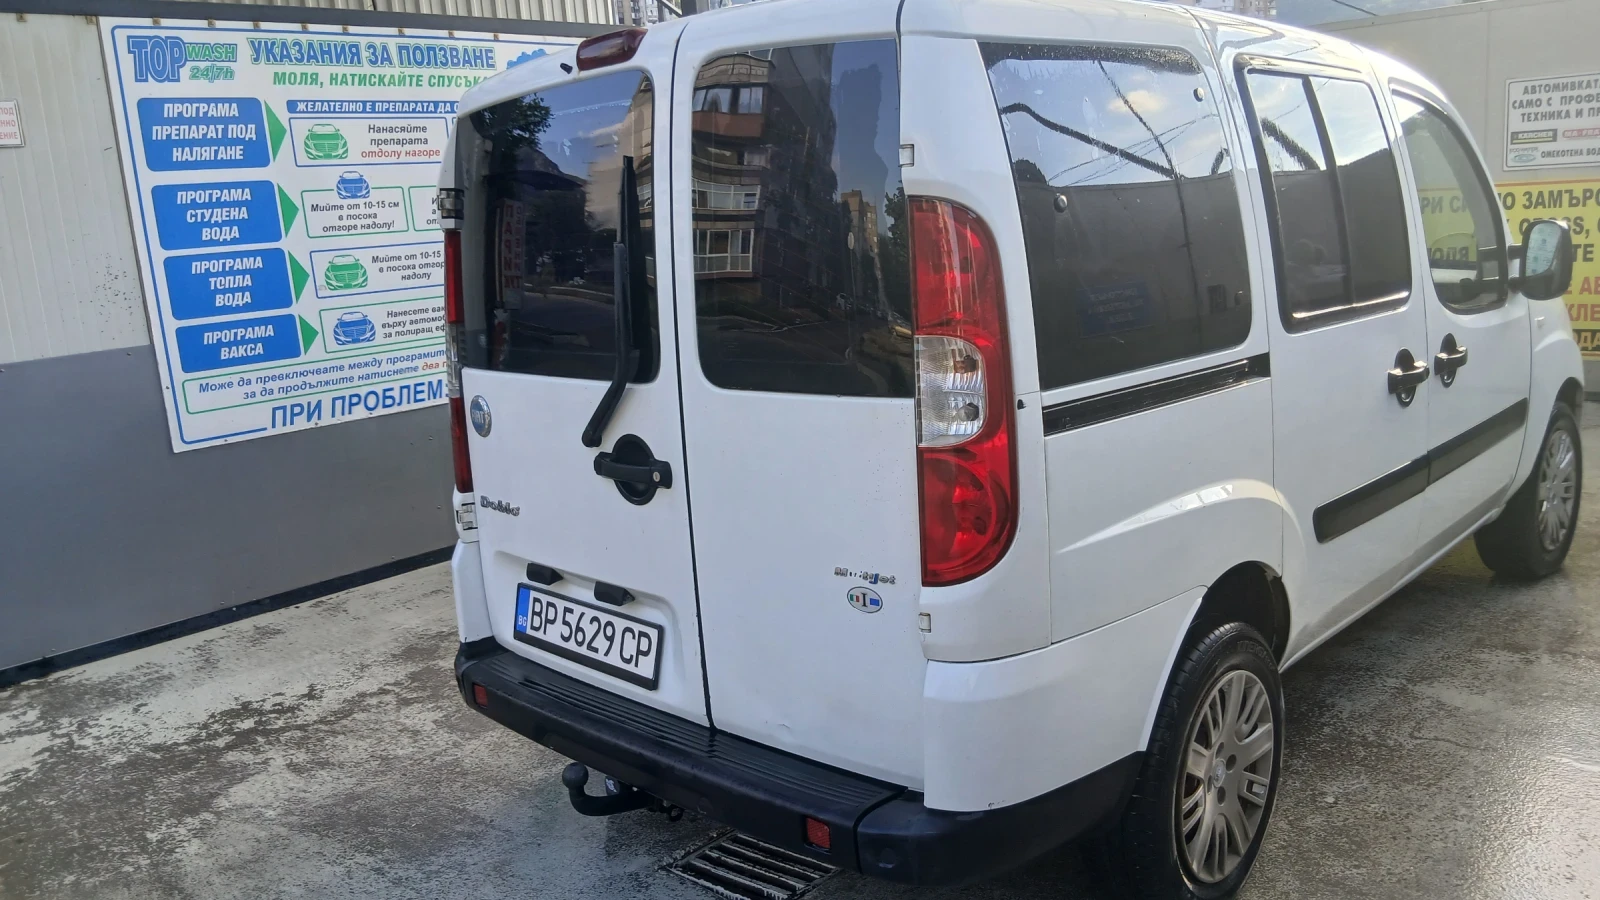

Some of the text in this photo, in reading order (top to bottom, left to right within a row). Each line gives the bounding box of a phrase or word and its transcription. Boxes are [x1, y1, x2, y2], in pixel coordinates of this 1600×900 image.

[127, 35, 187, 83] TOP
[185, 43, 237, 62] WASH
[247, 38, 498, 70] УКАЗАНИЯ ЗА ПОЛЗВАНЕ
[273, 70, 487, 88] МОЛЯ, НАТИСКАЙТЕ СПУСЪК
[1522, 79, 1600, 95] АВТОМИВКАТ
[164, 103, 239, 118] ПРОГРАМА
[296, 101, 363, 113] ЖЕЛАТЕЛНО
[365, 102, 373, 113] Е
[375, 102, 435, 113] ПРЕПАРАТА
[437, 102, 452, 114] ДА
[1511, 98, 1543, 110] САМО
[1520, 109, 1571, 123] ТЕХНИКА
[1575, 108, 1583, 118] И
[153, 124, 257, 141] ПРЕПАРАТ ПОД
[368, 123, 428, 135] Нанасяйте
[370, 137, 429, 148] препарата
[173, 145, 244, 162] НАЛЯГАНЕ
[361, 147, 441, 160] отдолу нагоре
[177, 187, 252, 204] ПРОГРАМА
[310, 203, 345, 213] Мийте
[348, 203, 361, 211] от
[363, 202, 386, 210] 10-15
[1420, 195, 1444, 215] РИ
[186, 206, 249, 223] СТУДЕНА
[346, 212, 378, 221] посока
[202, 226, 240, 242] ВОДА
[322, 220, 395, 233] отгоре надолу!
[371, 250, 442, 264] Мийте от 10-15
[1571, 243, 1595, 262] ТЕ
[191, 256, 263, 275] ПРОГРАМА
[386, 263, 416, 273] посока
[418, 261, 445, 272] отгор
[208, 274, 252, 290] ТОПЛА
[401, 271, 432, 281] надолу
[215, 291, 252, 308] ВОДА
[386, 308, 430, 319] Нанесете
[381, 319, 407, 330] върху
[394, 327, 434, 337] полиращ
[203, 324, 275, 345] ПРОГРАМА
[220, 343, 264, 360] ВАКСА
[199, 379, 234, 394] Може
[237, 375, 252, 388] да
[255, 363, 345, 387] превключвате
[348, 357, 384, 372] между
[386, 349, 447, 366] програмит
[243, 391, 257, 400] за
[260, 386, 274, 398] да
[277, 374, 355, 397] продължите
[357, 364, 419, 383] натиснете
[421, 361, 440, 371] два
[270, 400, 323, 429] ПРИ
[518, 614, 527, 626] BG
